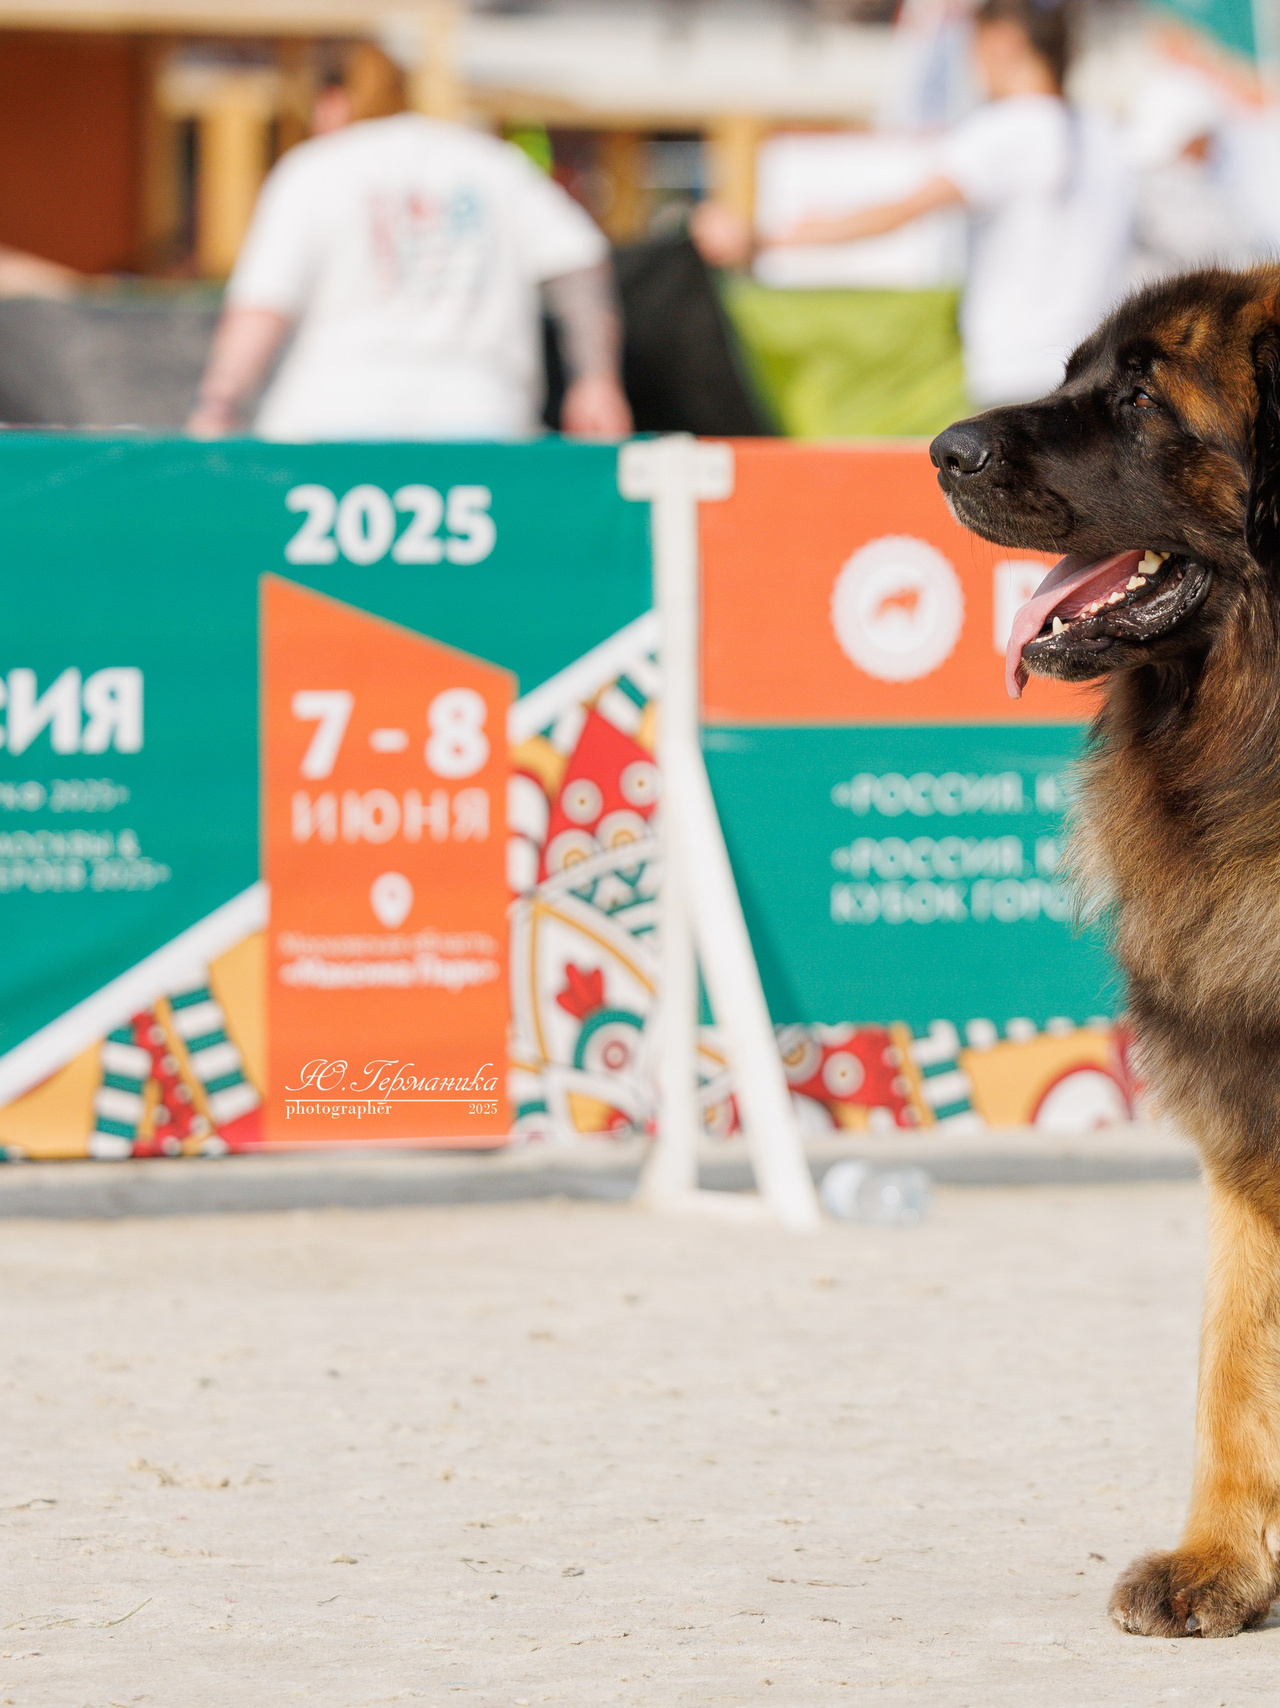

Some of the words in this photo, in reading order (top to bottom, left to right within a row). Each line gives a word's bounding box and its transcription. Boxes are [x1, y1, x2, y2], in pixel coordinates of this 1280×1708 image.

[285, 484, 498, 566] 2025
[0, 665, 145, 757] ИЯ
[291, 787, 490, 843] ИЮНЯ
